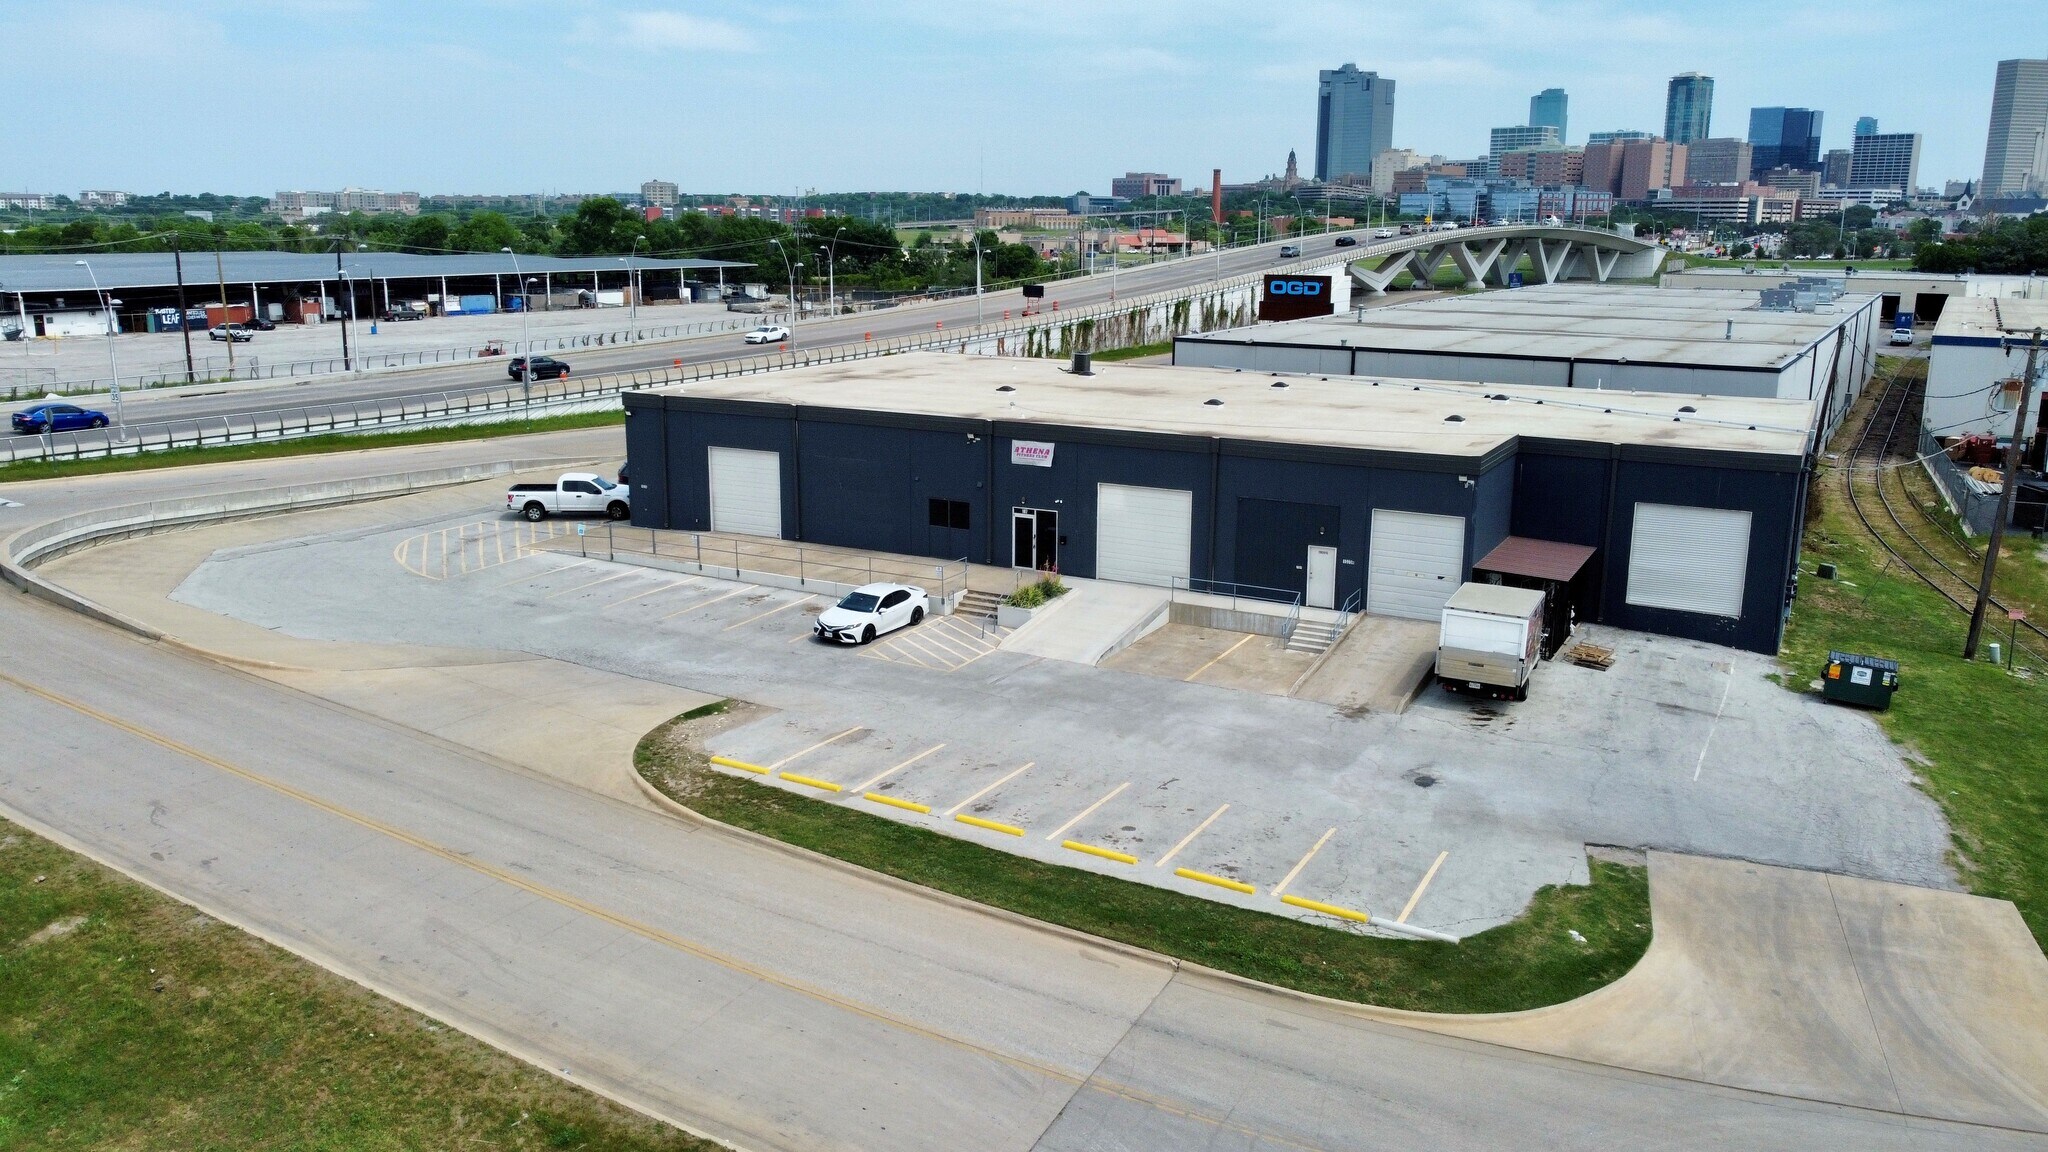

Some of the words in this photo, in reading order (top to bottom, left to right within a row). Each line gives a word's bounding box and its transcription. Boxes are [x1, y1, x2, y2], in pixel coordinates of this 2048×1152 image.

[1270, 281, 1320, 295] OGD
[162, 313, 180, 324] LEAF
[1014, 447, 1050, 455] ATHENA
